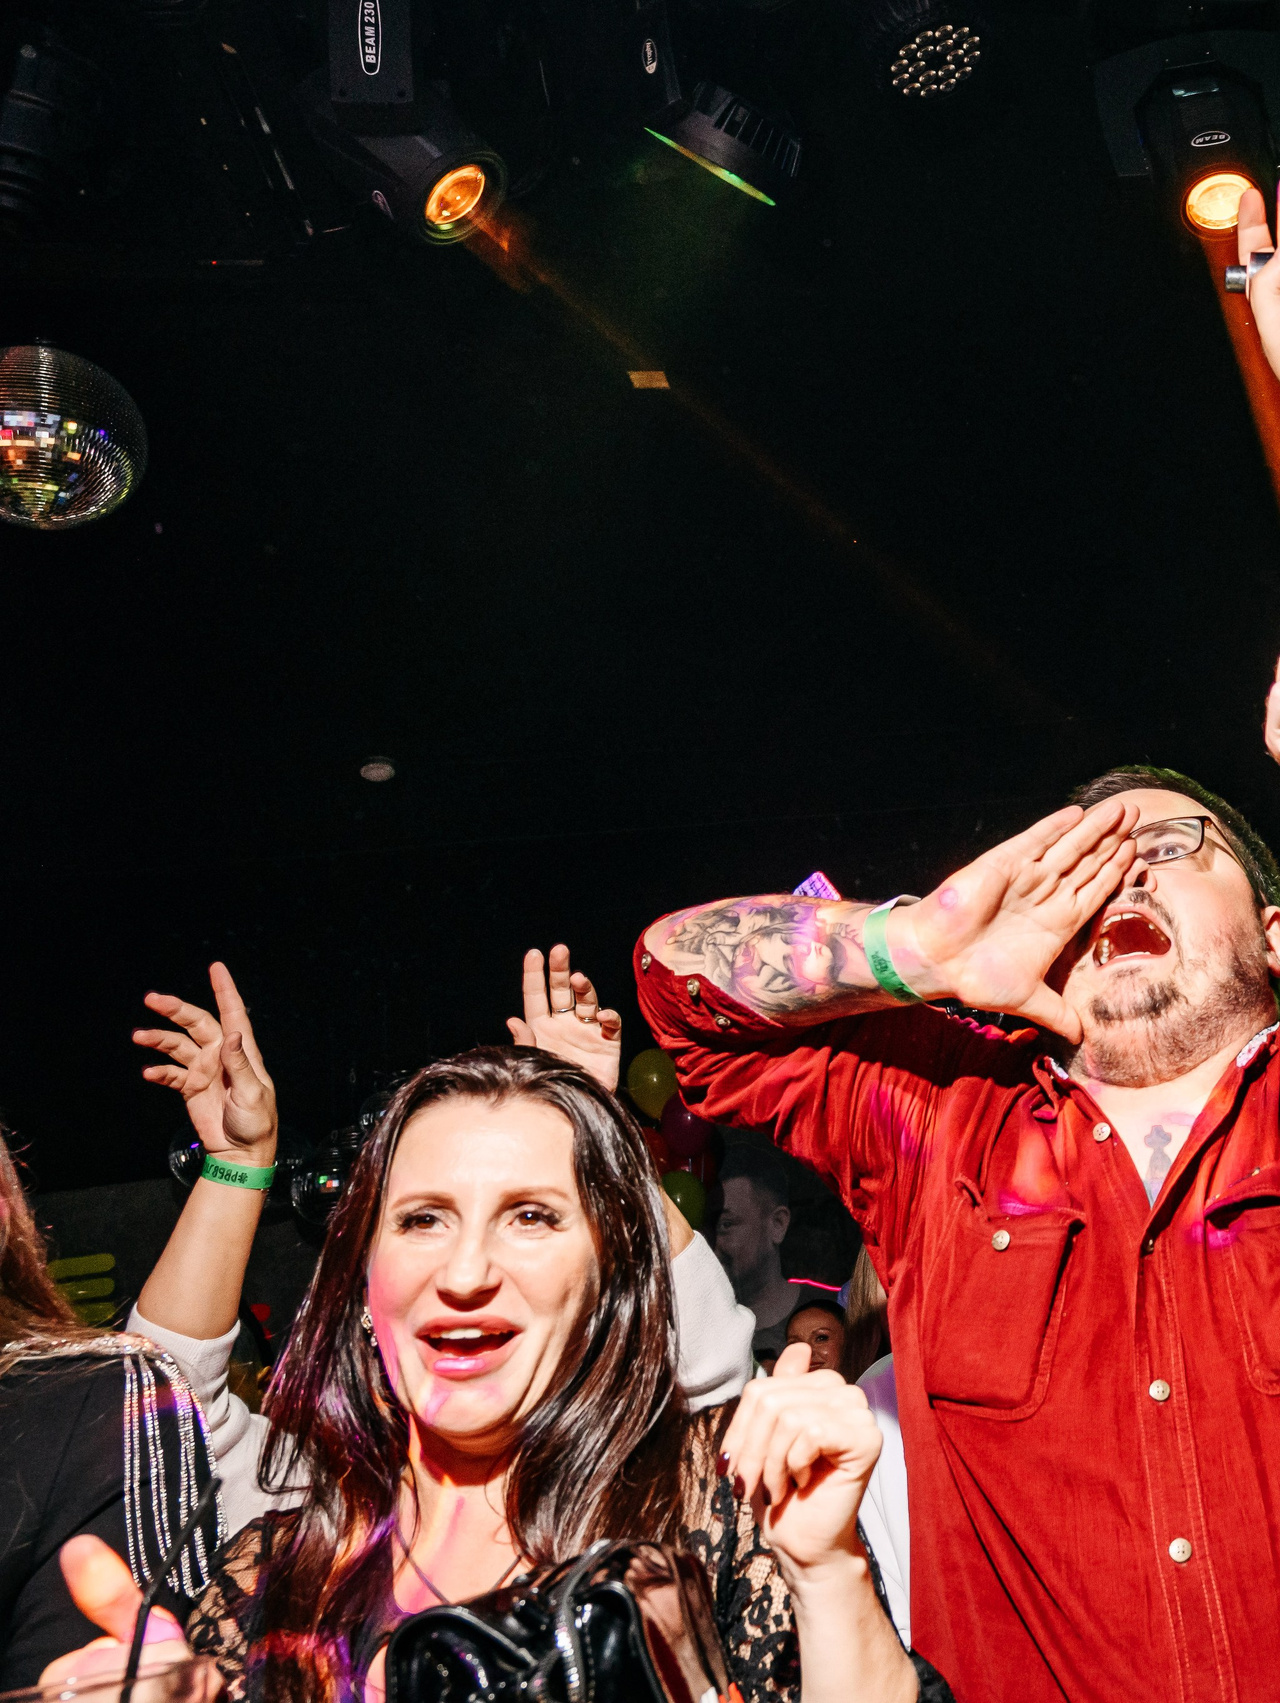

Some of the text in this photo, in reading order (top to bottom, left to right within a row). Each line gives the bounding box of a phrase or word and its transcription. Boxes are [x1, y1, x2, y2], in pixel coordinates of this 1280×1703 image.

[363, 1, 376, 64] BEAM 230
[1195, 134, 1226, 145] BEAM
